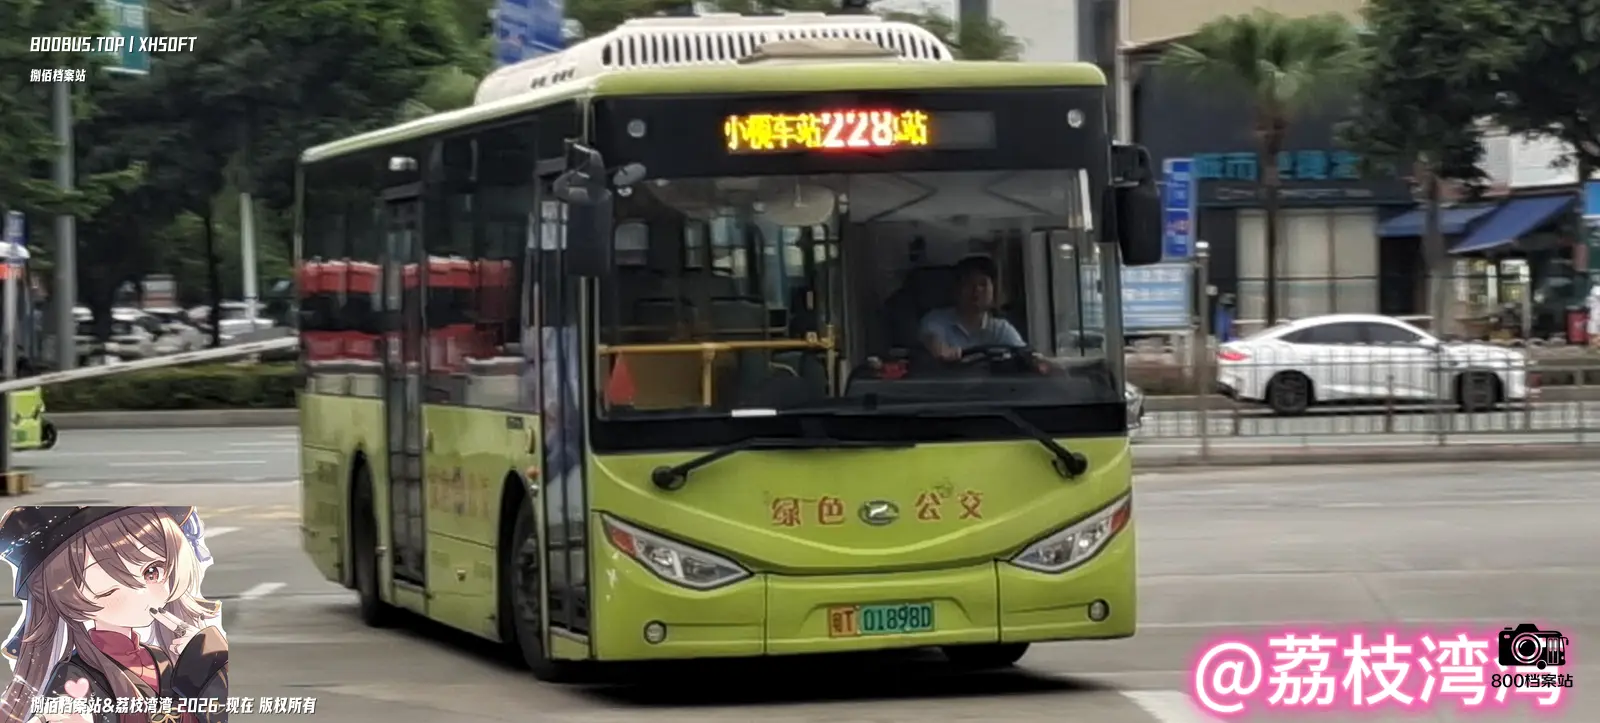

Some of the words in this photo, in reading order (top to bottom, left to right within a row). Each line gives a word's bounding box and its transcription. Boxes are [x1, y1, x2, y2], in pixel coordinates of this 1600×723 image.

[821, 110, 894, 148] 228
[771, 495, 846, 527] 绿色
[914, 489, 984, 522] 公交
[863, 605, 932, 631] 01898D
